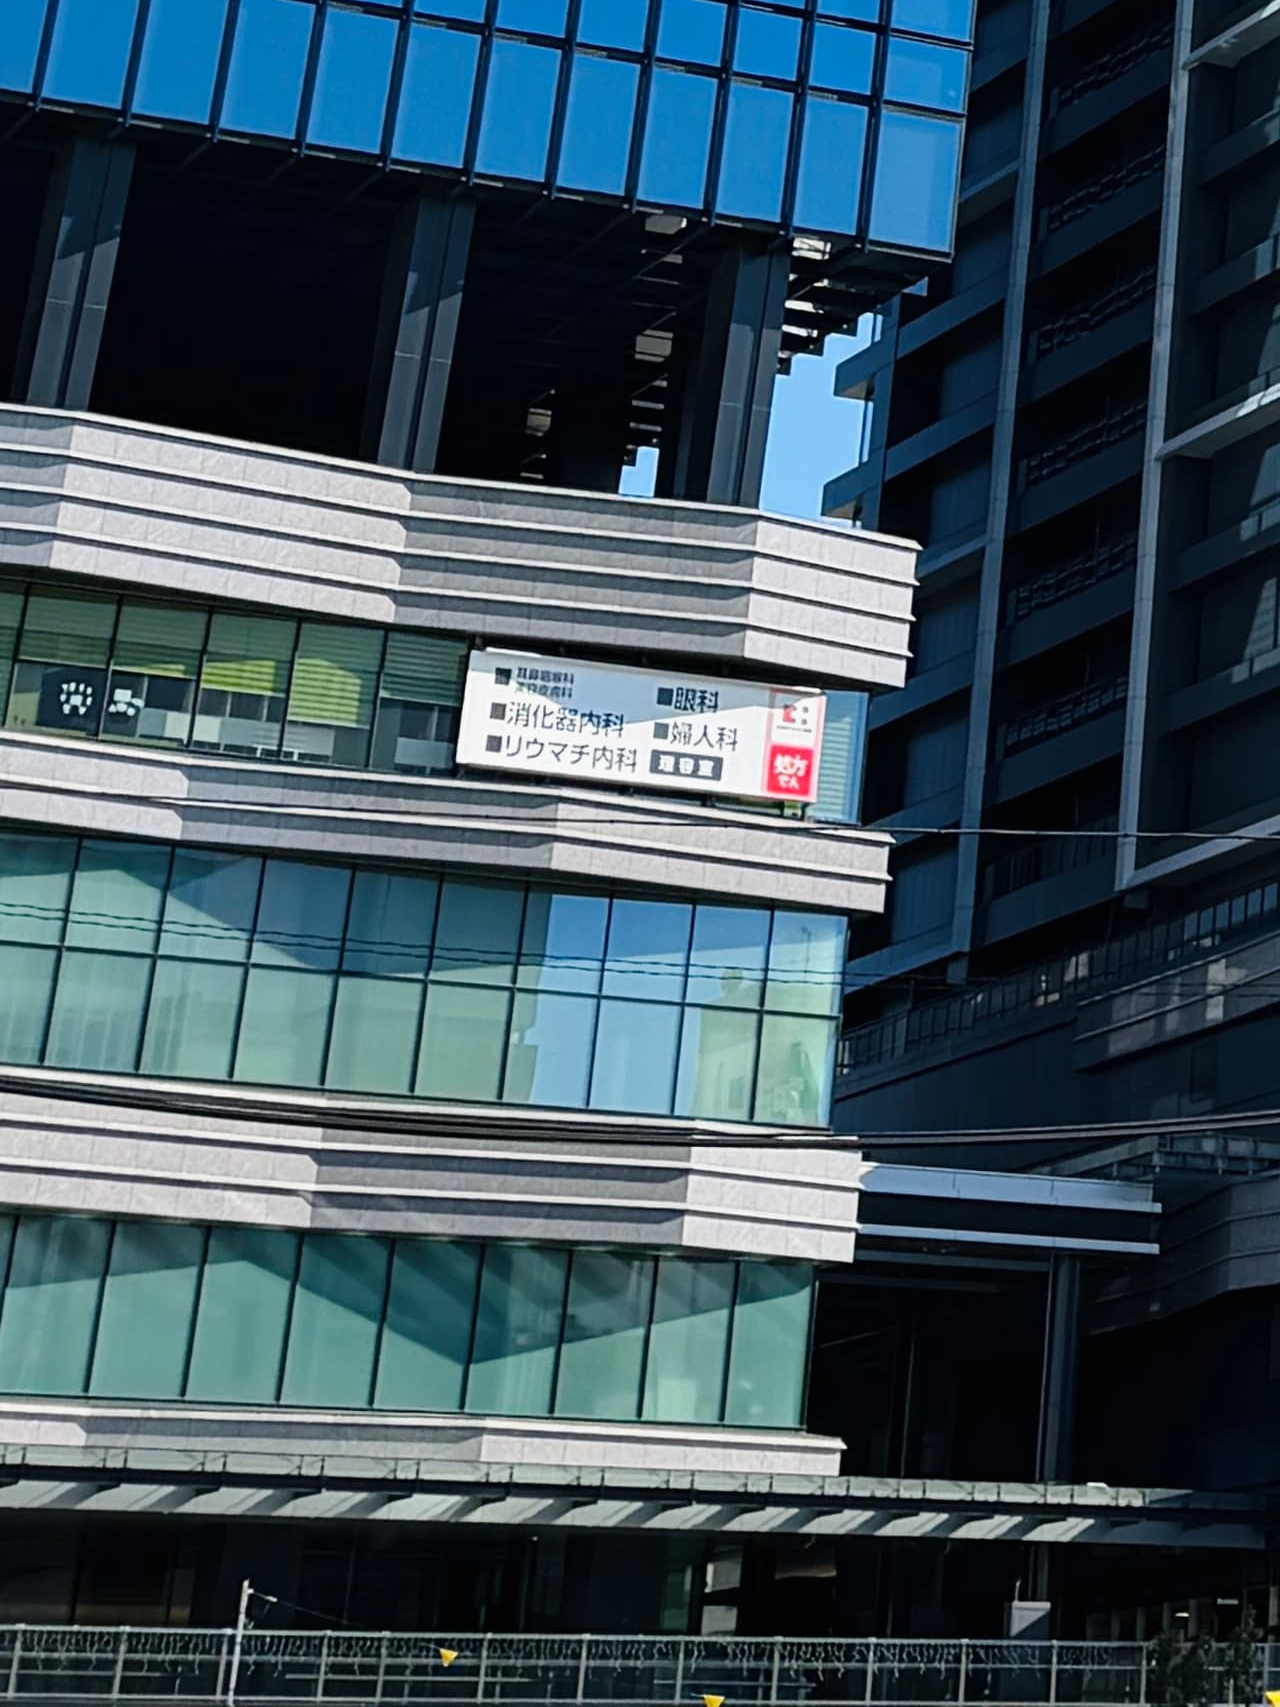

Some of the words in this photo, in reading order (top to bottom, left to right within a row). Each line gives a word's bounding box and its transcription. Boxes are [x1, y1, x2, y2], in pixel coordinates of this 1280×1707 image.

[674, 687, 719, 713] 眼科
[507, 701, 624, 737] 消化器内科
[670, 721, 738, 752] 婦人科
[506, 735, 637, 772] リウマチ内科
